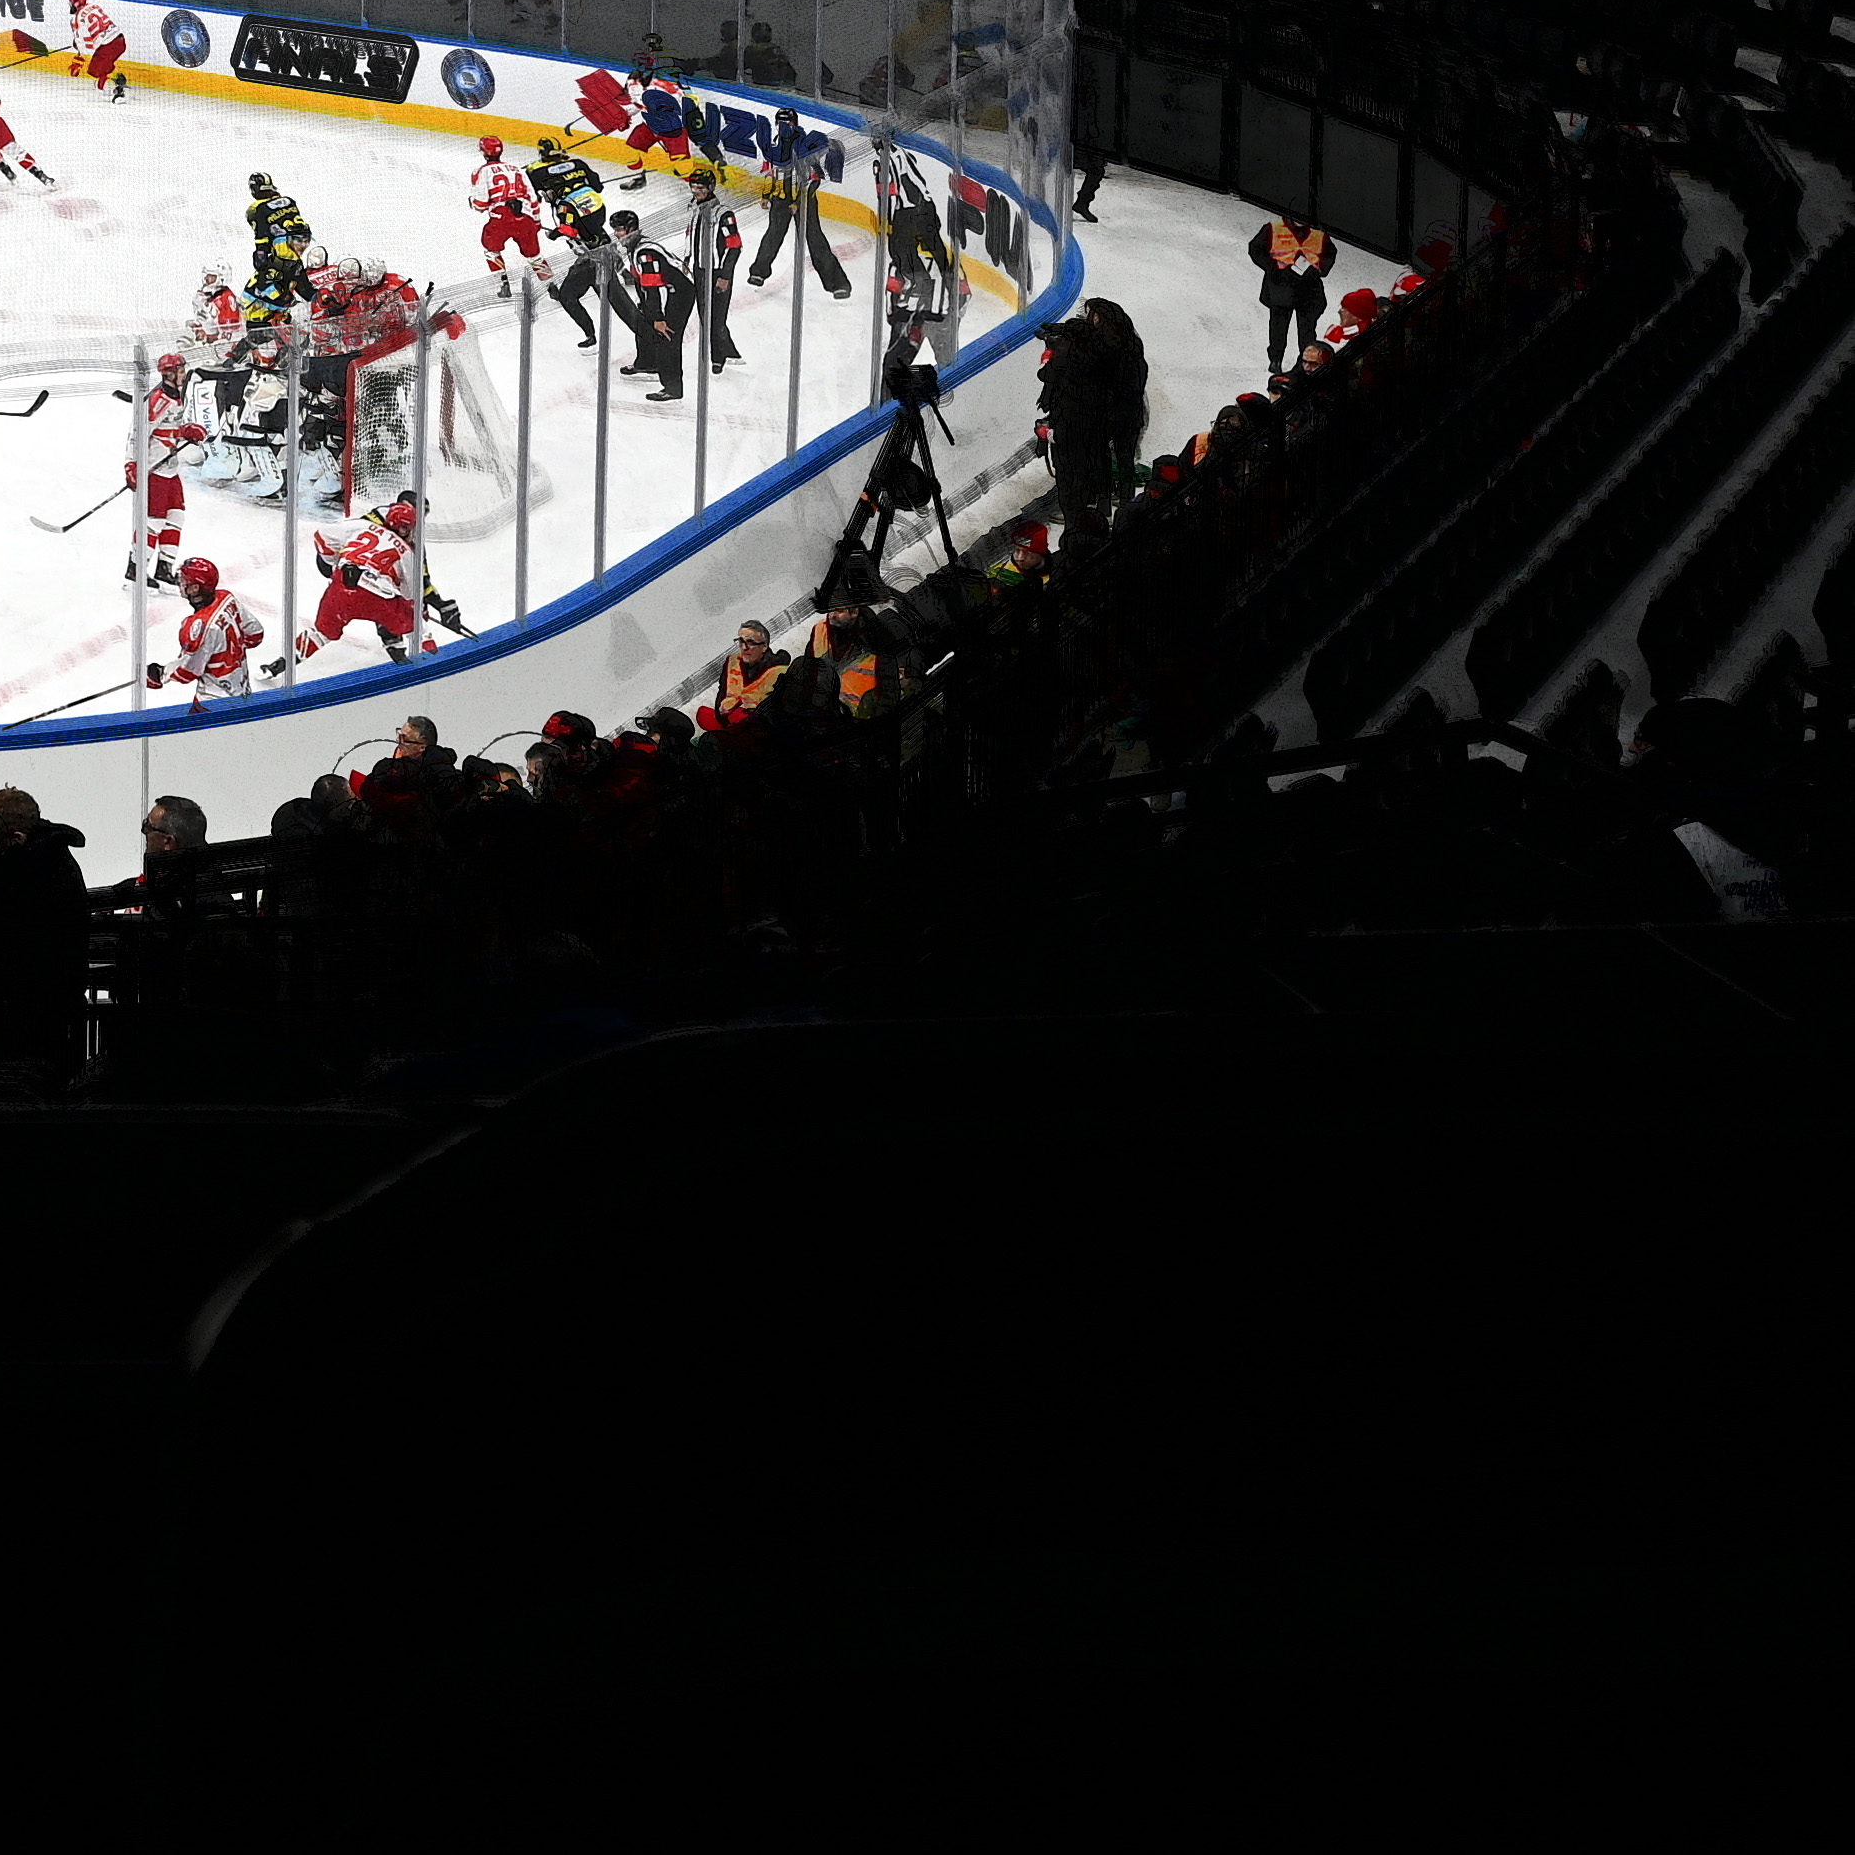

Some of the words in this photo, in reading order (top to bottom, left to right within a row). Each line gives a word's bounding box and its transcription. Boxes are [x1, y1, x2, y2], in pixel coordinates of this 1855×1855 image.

[492, 172, 527, 199] 24
[369, 524, 385, 537] DA
[388, 536, 406, 555] TOS
[346, 531, 401, 587] 24
